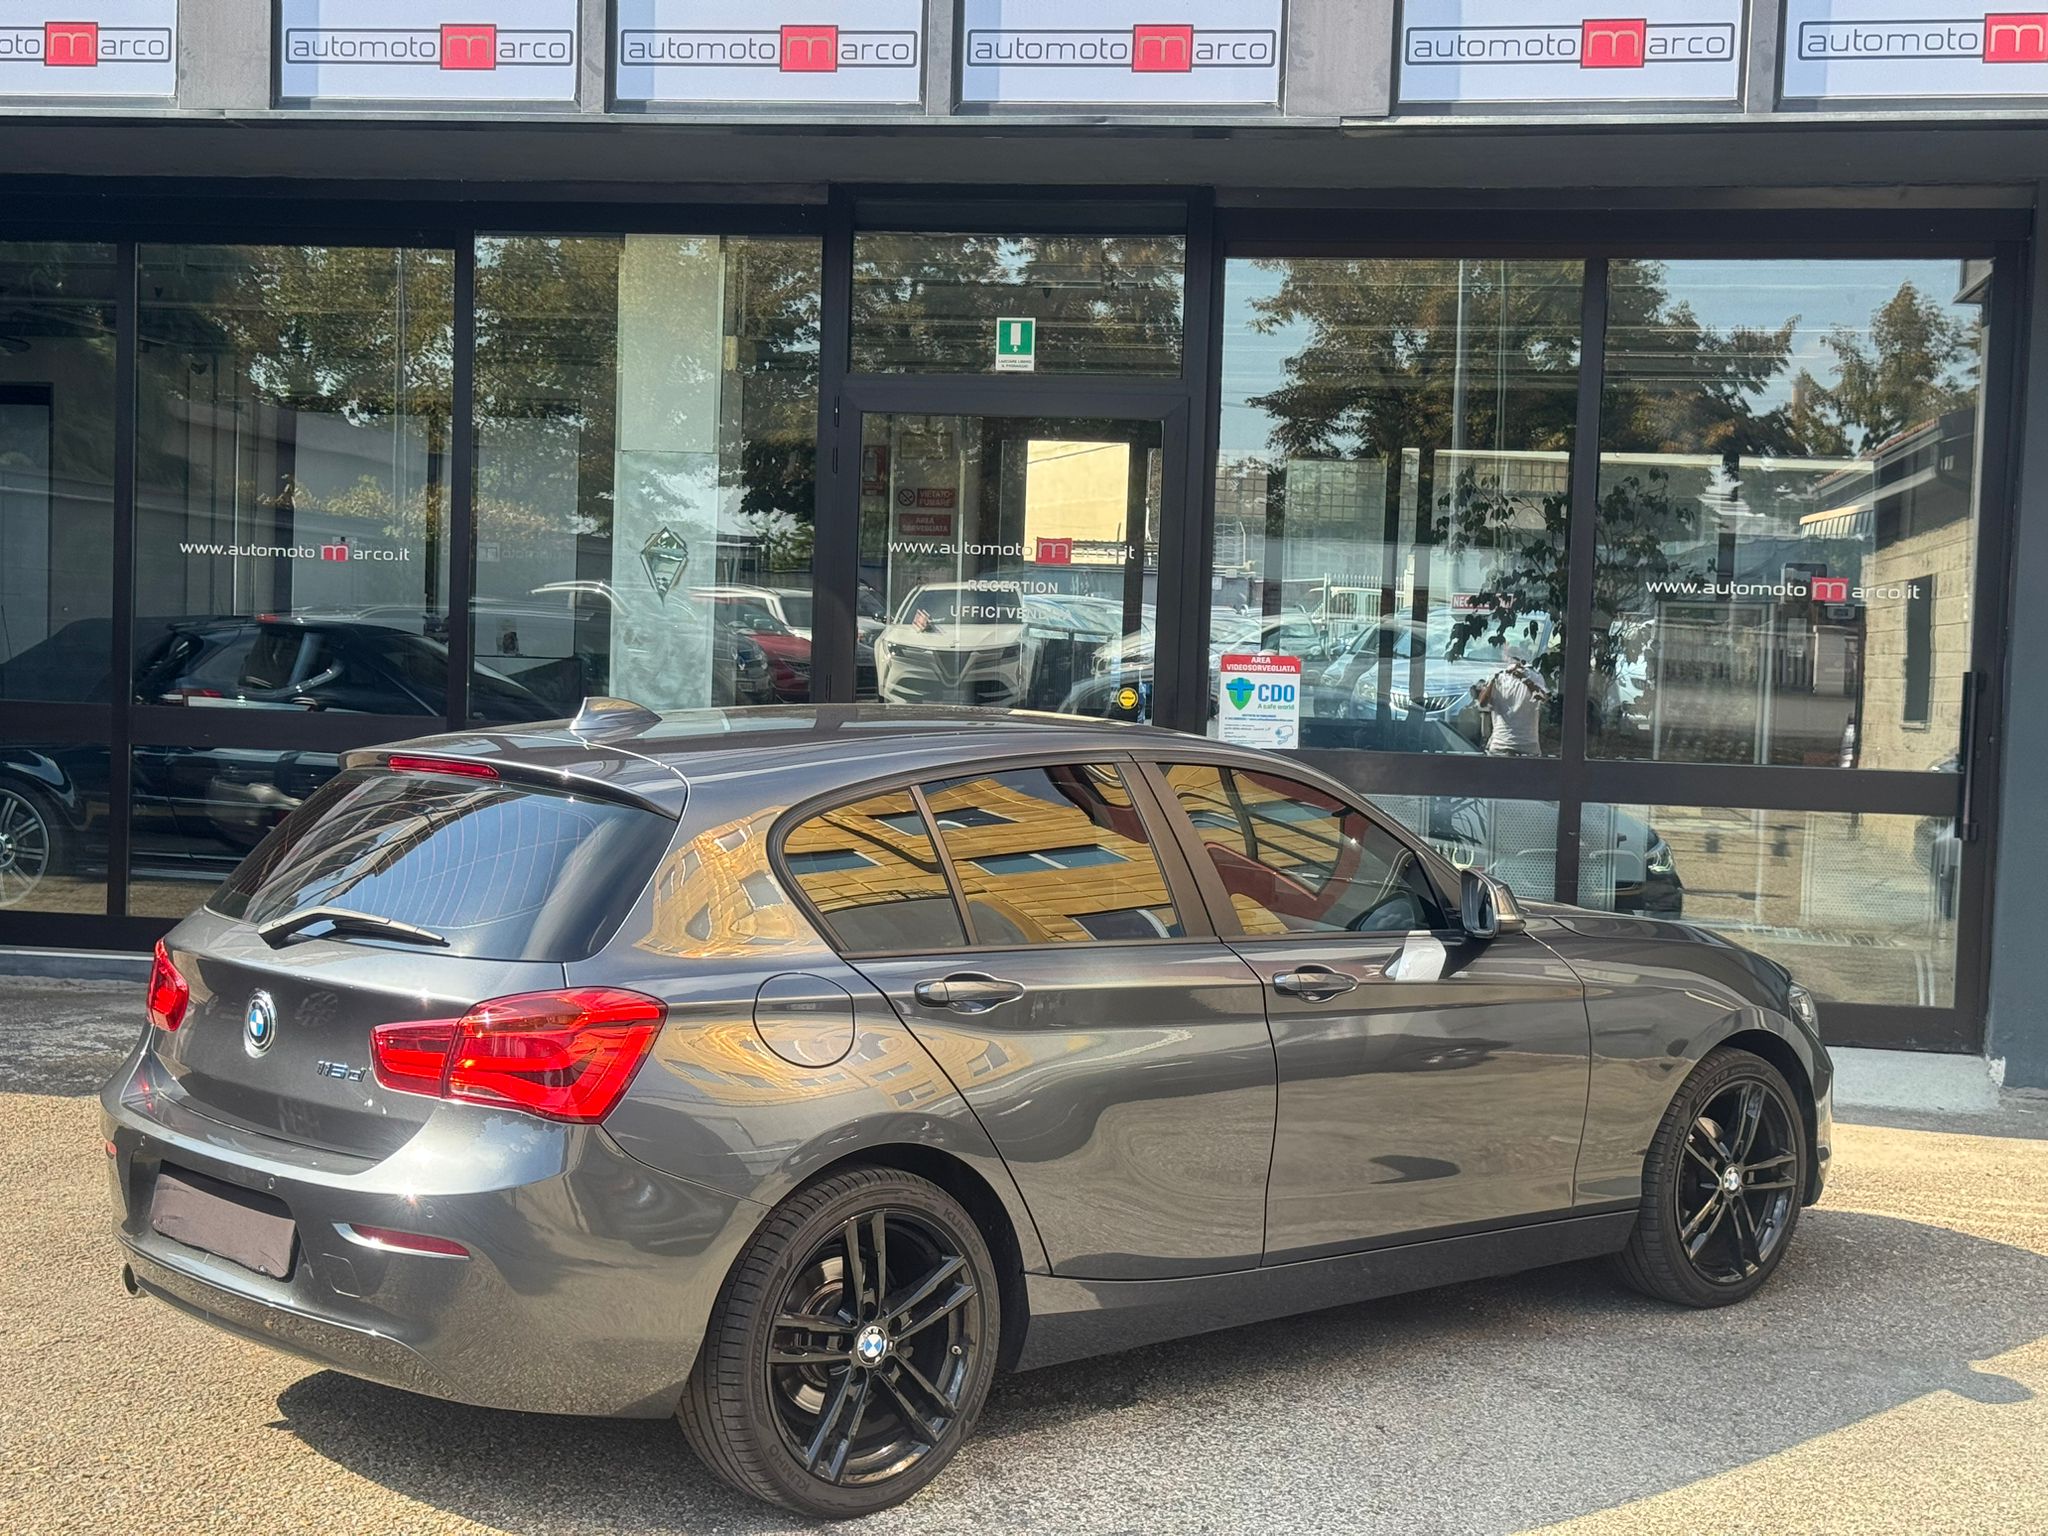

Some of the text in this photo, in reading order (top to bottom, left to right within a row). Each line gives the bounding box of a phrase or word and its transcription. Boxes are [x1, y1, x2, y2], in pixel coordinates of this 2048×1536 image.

[967, 579, 1059, 594] RECEPTION
[950, 605, 1000, 619] UFFICI
[1251, 656, 1271, 664] AREA
[1257, 683, 1295, 703] CDO
